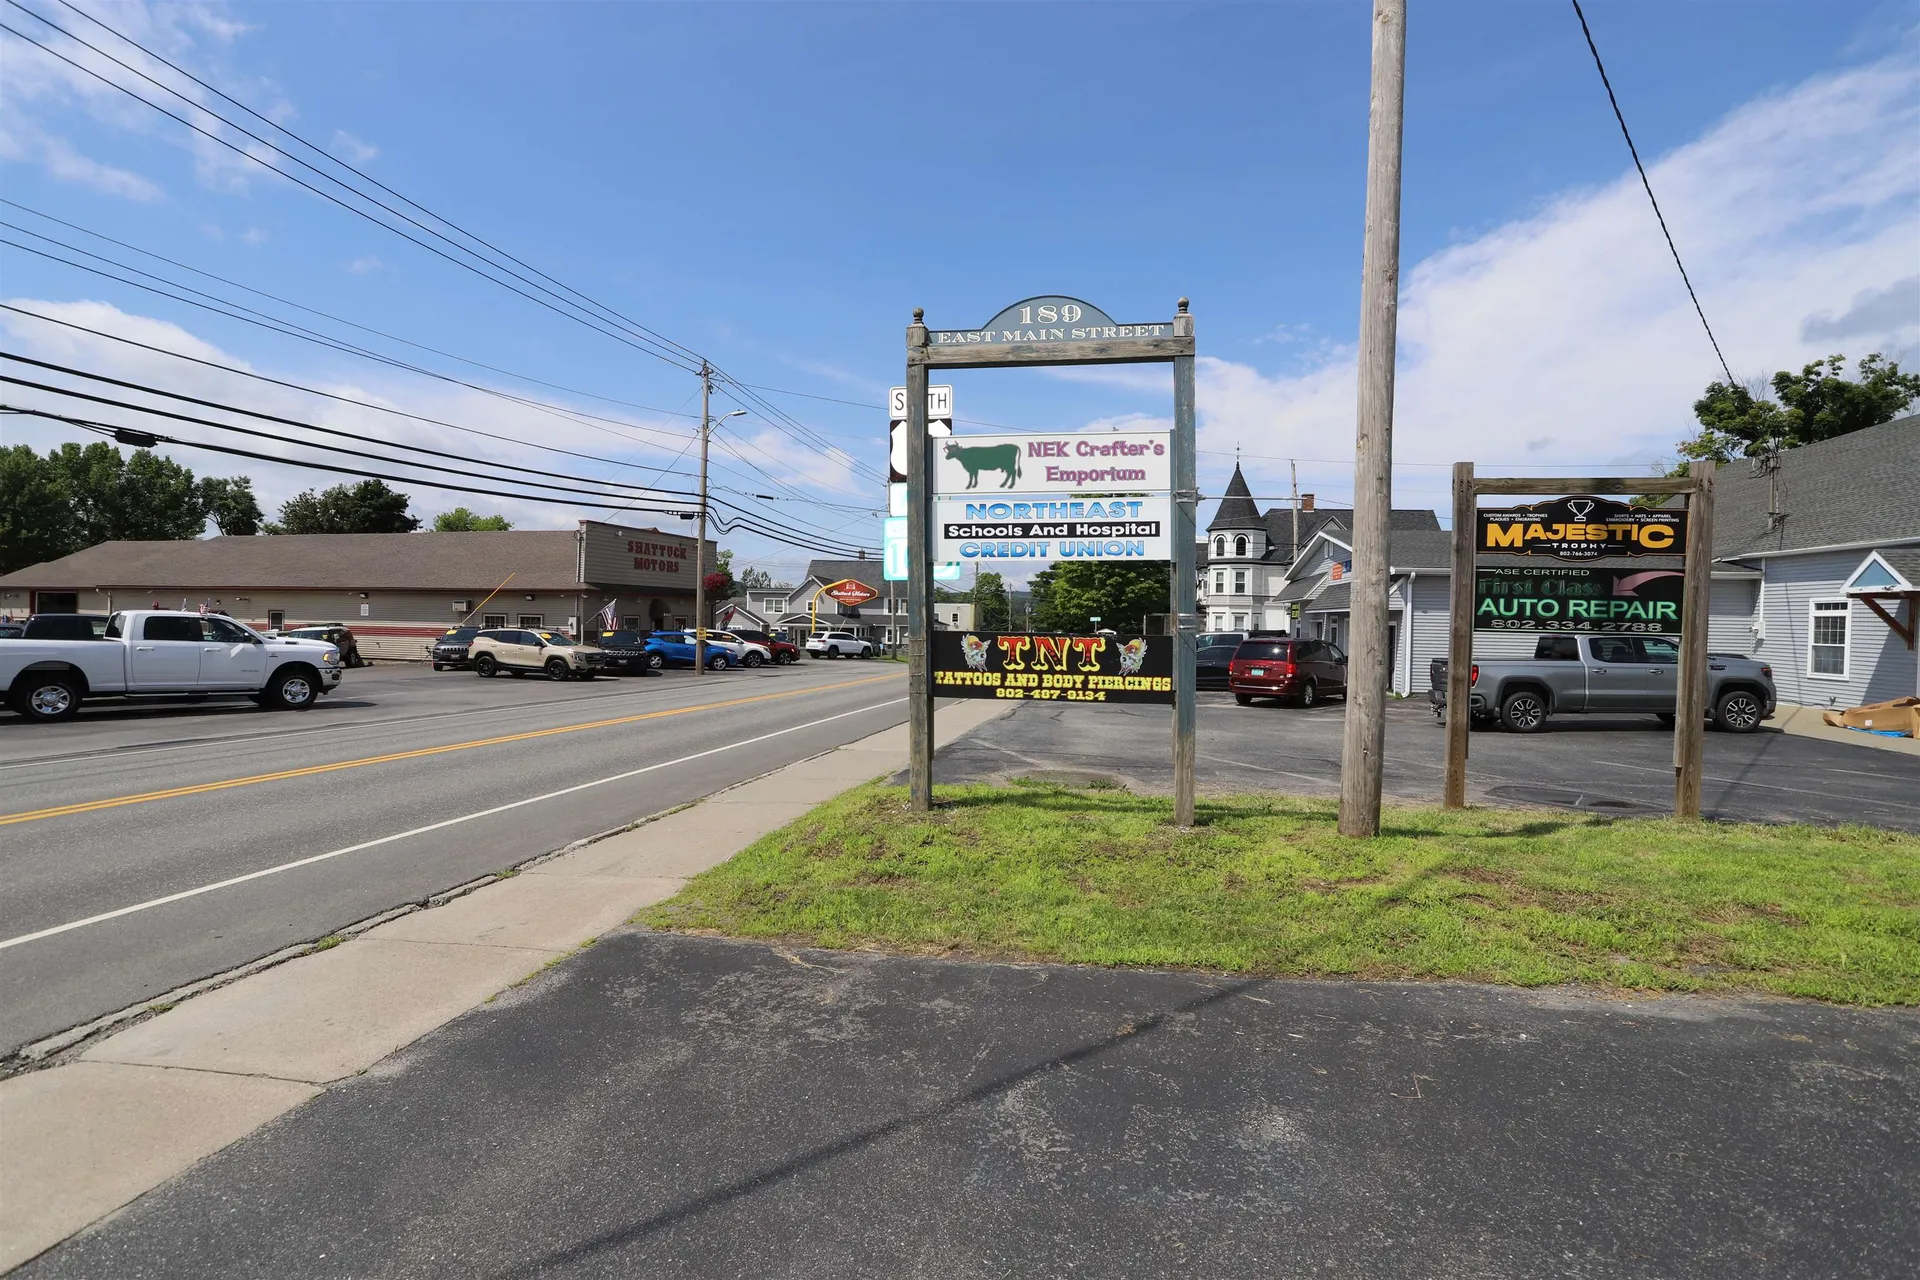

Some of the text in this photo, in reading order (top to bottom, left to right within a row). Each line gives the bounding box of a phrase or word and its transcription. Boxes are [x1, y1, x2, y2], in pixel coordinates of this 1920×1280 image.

[1019, 304, 1082, 324] 189
[937, 324, 1165, 344] EAST MAIN STREET
[895, 392, 947, 411] STH
[1027, 439, 1165, 458] NEK Crafter's
[1045, 465, 1146, 486] Emporium
[965, 501, 1143, 520] NORTHEAST
[948, 522, 1156, 538] Schools And Hospital
[1486, 523, 1675, 549] MAJESTIC
[627, 540, 687, 560] SHATTUCK
[959, 540, 1145, 558] CREDIT UNION
[633, 557, 680, 573] MOTORS
[1523, 568, 1590, 576] CERTIFIED
[1478, 577, 1605, 597] First Class
[1476, 598, 1679, 621] AUTO REPAIR
[1490, 619, 1663, 633] 802.334.2788
[997, 635, 1107, 672] TNT
[933, 671, 1172, 691] TATTOOS AND BODY PIERCINGS
[995, 687, 1107, 701] 802-487-9134
